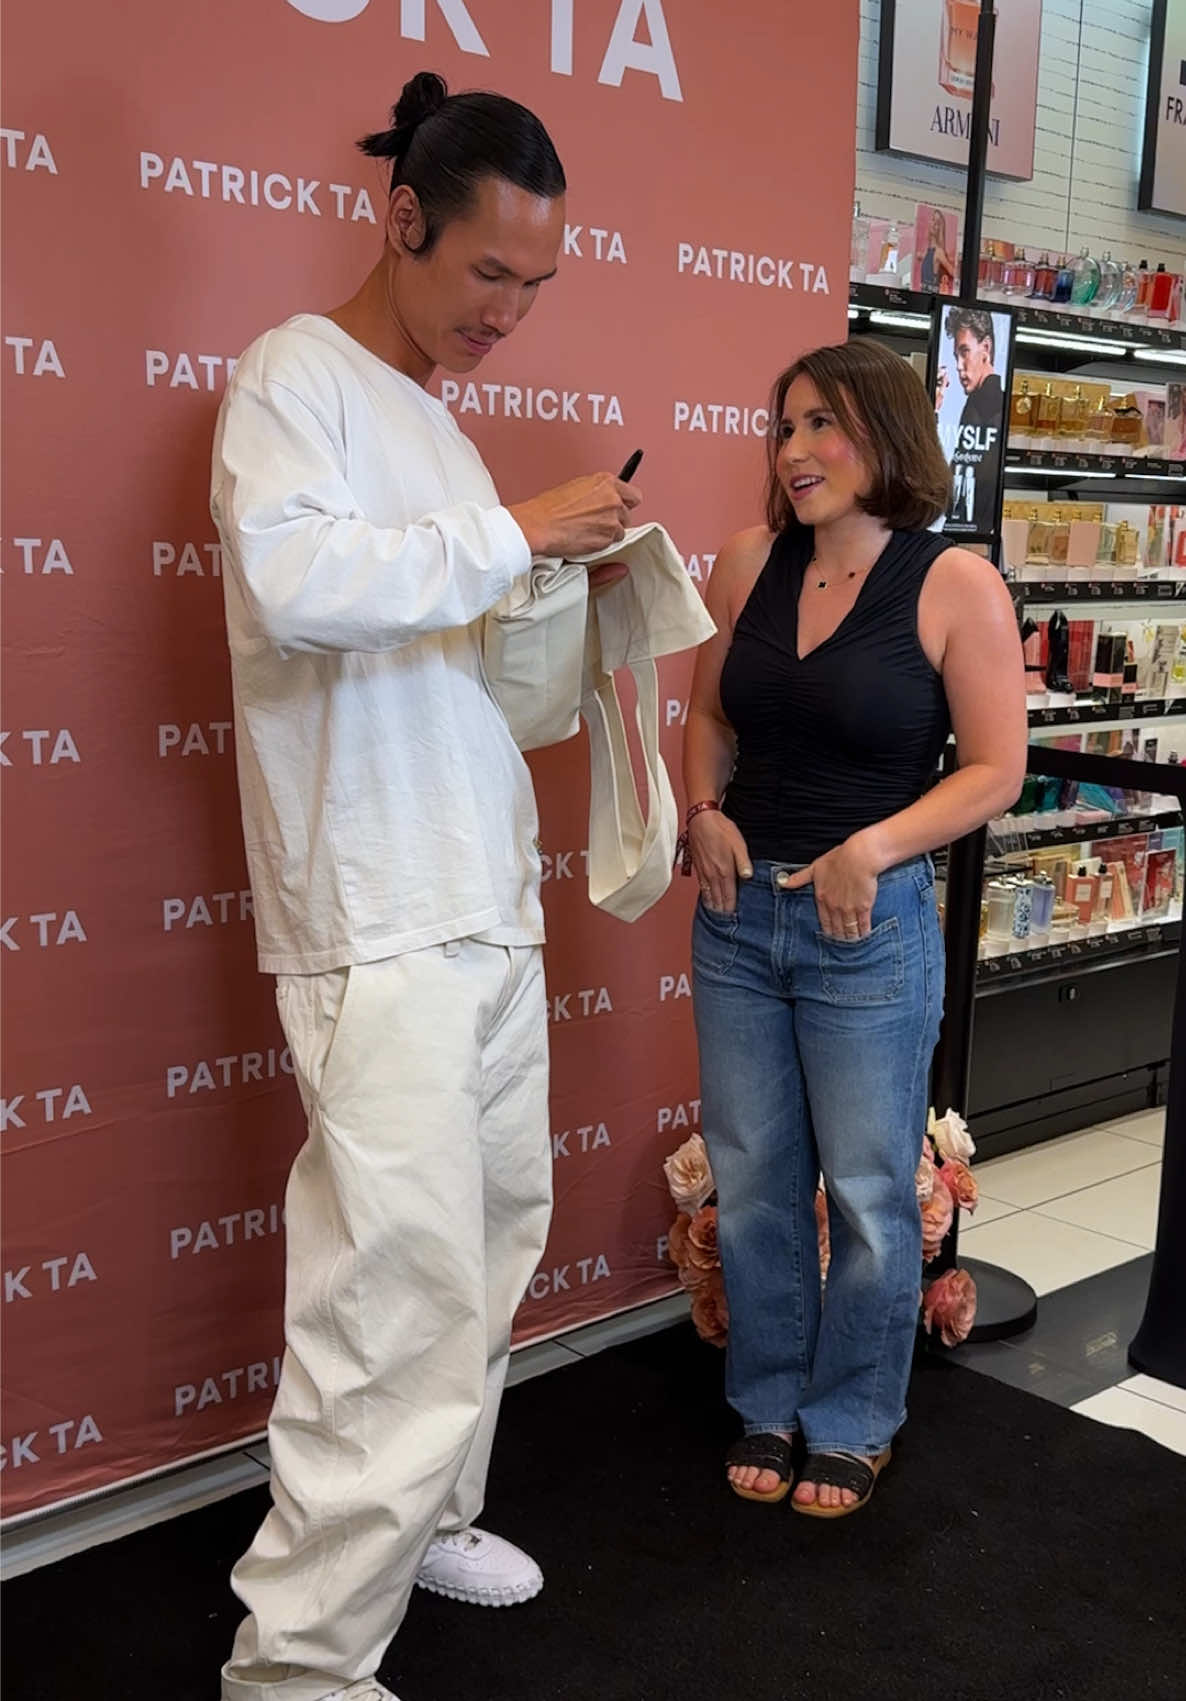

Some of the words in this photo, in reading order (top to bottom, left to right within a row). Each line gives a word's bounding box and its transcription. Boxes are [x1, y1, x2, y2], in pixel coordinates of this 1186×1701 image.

[930, 105, 1000, 147] ARMI
[0, 128, 58, 174] TA
[140, 152, 321, 216] PATRICK
[329, 183, 377, 224] TA
[590, 228, 627, 264] TA
[677, 243, 793, 289] PATRICK
[799, 263, 830, 295] TA
[5, 336, 65, 378] TA
[441, 380, 580, 423] PATRICK
[587, 394, 624, 427] TA
[13, 537, 74, 575] TA
[23, 728, 81, 765] TA
[158, 722, 232, 757] PAT
[30, 910, 88, 947] TA
[578, 987, 613, 1017] TA
[36, 1084, 92, 1122] TA
[577, 1122, 611, 1152] TA
[170, 1204, 286, 1260] PATRI
[43, 1252, 98, 1291] TA
[577, 1255, 611, 1284] TA
[0, 1431, 40, 1472] K
[50, 1415, 103, 1454] TA
